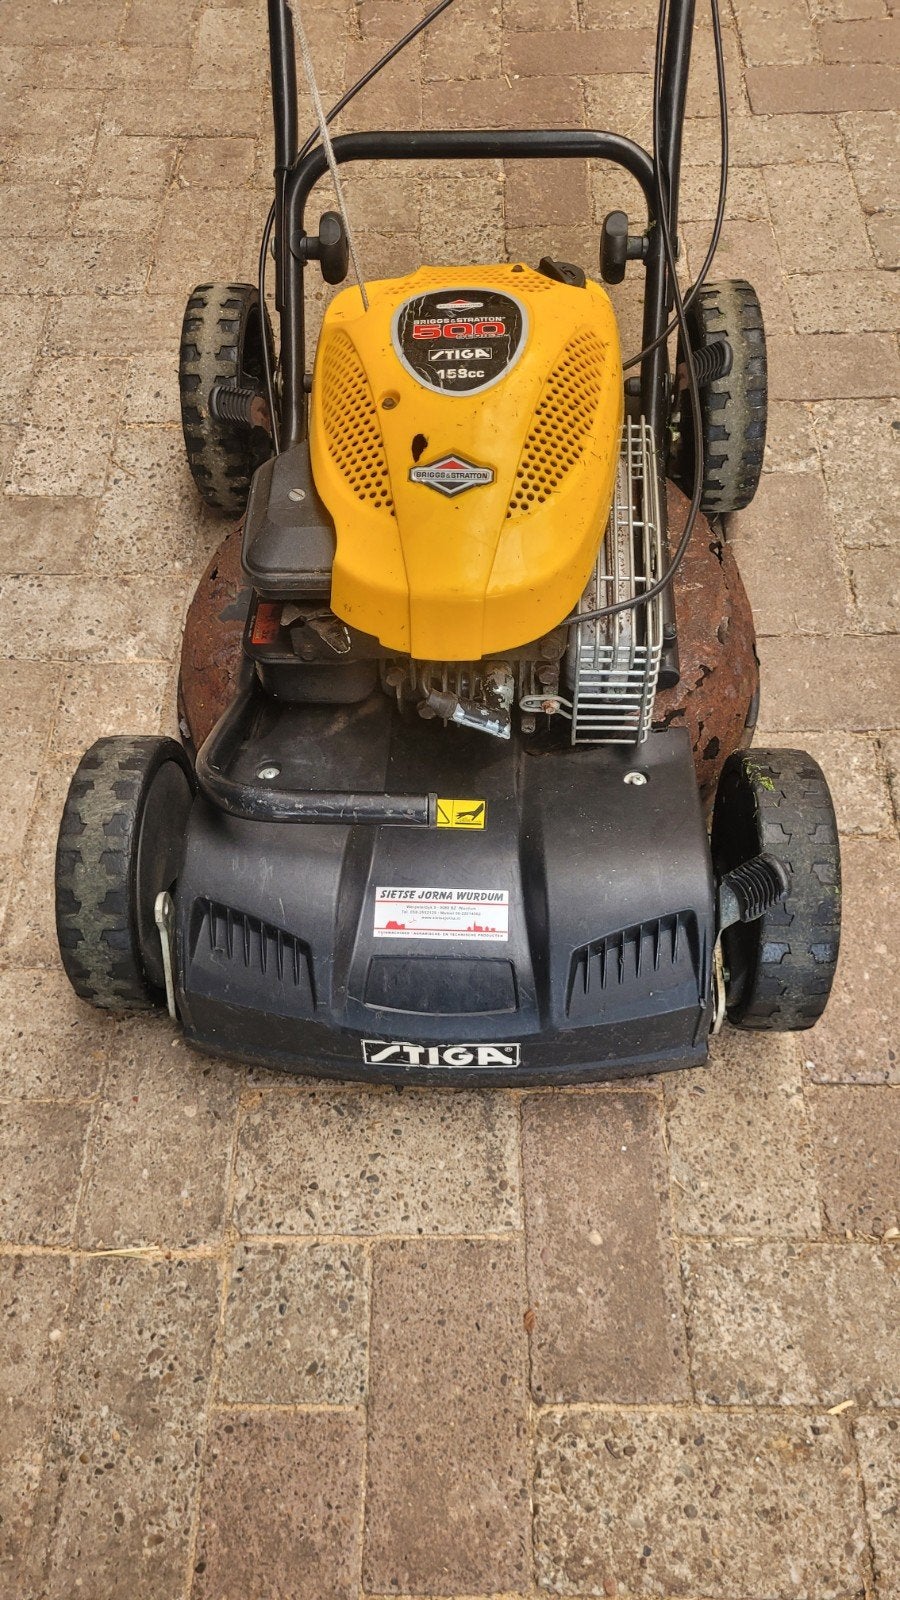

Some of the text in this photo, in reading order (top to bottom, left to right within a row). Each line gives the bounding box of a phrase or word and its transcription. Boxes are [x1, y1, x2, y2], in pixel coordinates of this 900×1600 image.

[412, 321, 506, 340] 500
[431, 348, 490, 360] STIGA
[380, 890, 504, 901] SIETSE JORNA WURDUM
[370, 1045, 513, 1066] STIGA
